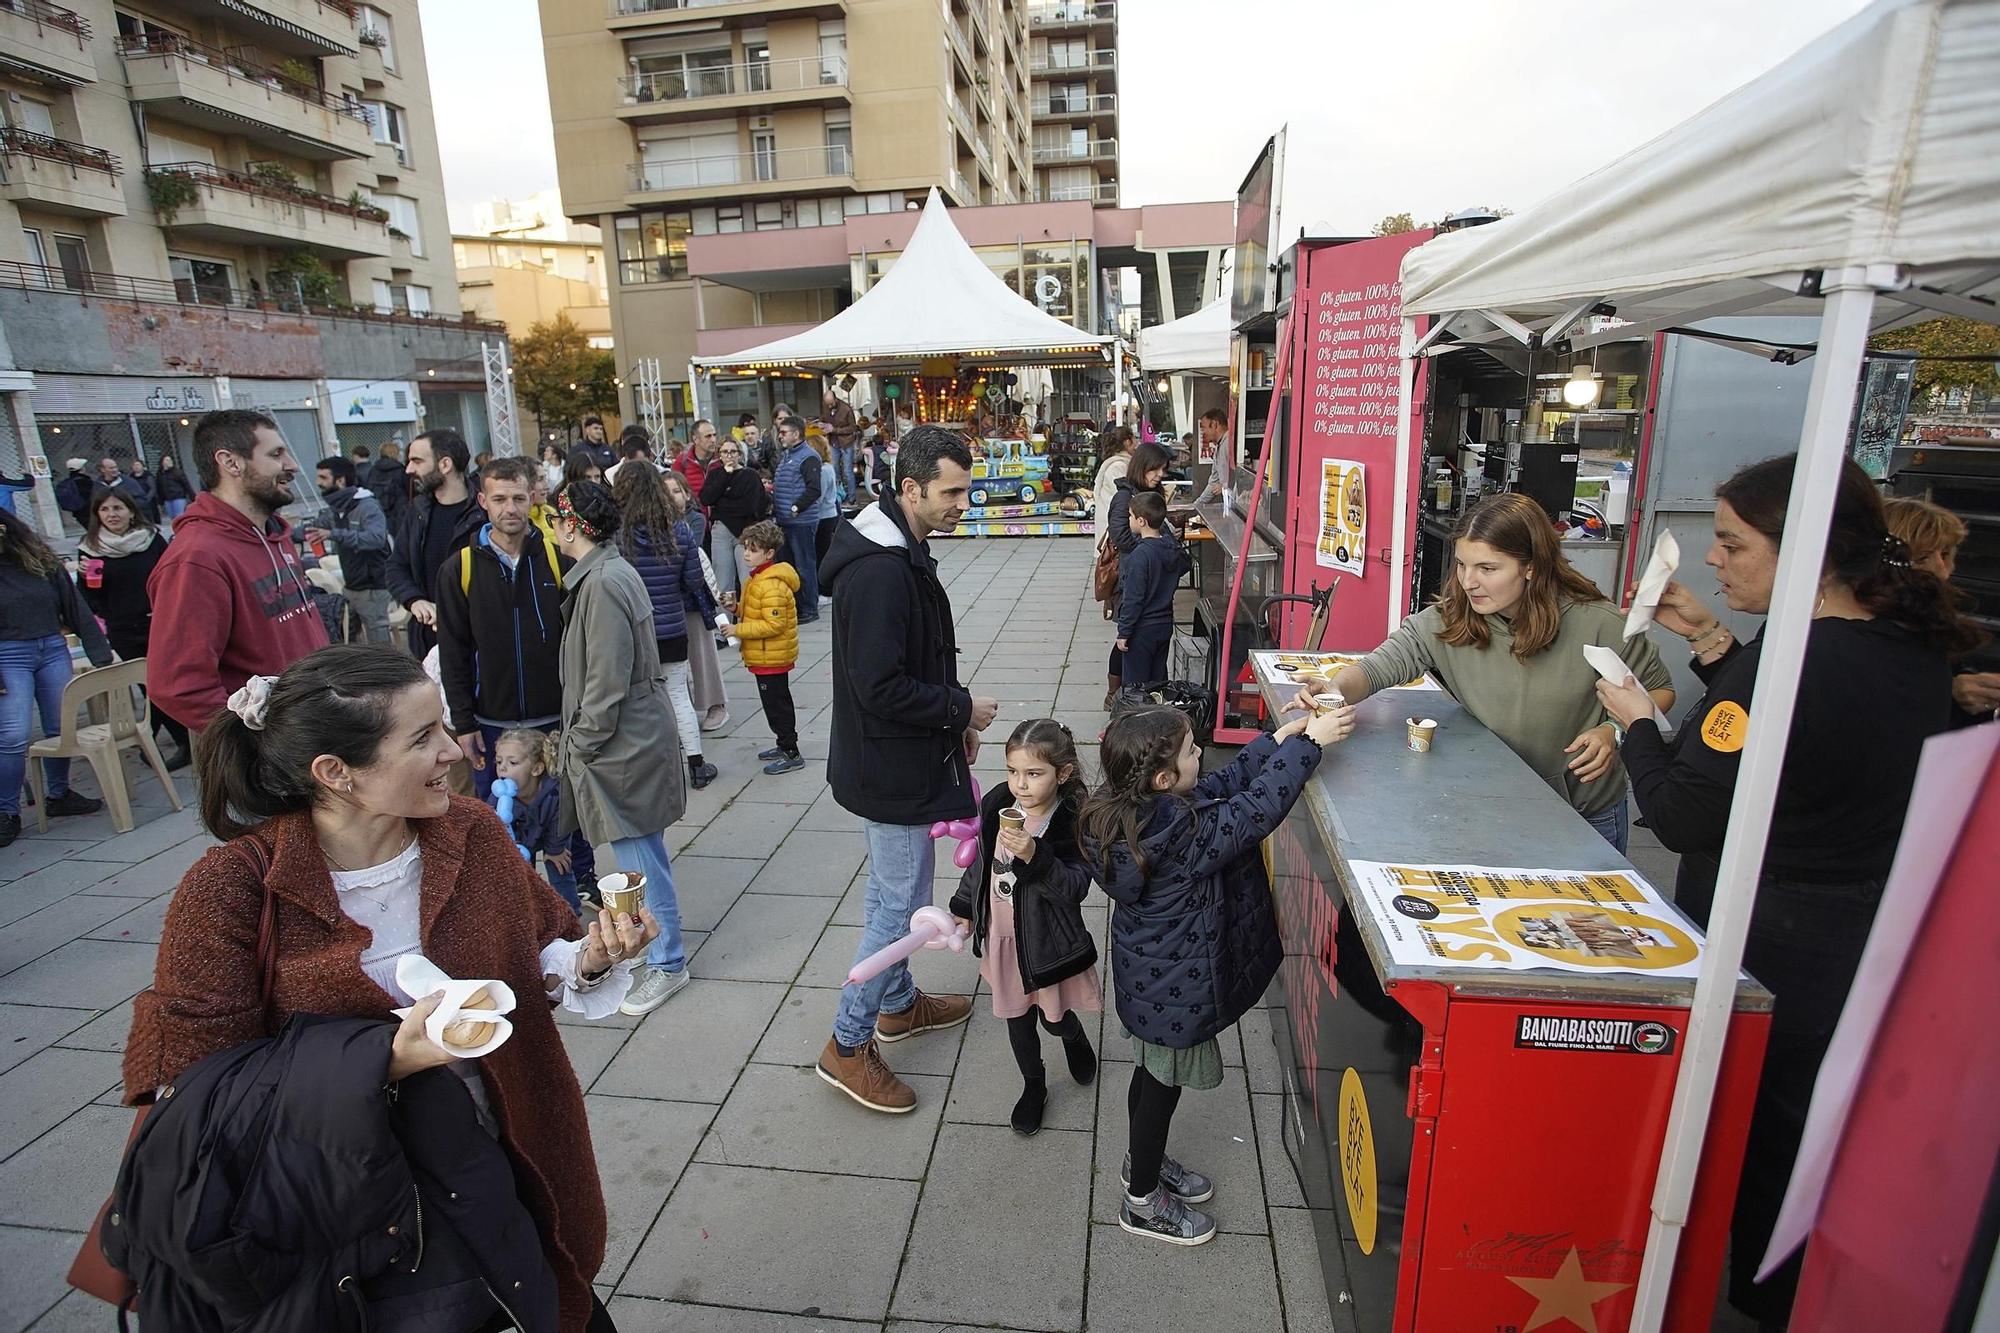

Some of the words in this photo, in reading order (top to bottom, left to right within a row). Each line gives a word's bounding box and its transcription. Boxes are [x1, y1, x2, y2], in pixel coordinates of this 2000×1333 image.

[1320, 292, 1333, 306] 0%
[1334, 290, 1362, 307] gluten.
[1365, 284, 1389, 300] 100%
[1320, 310, 1332, 324] 0%
[1333, 309, 1361, 326] gluten.
[1364, 304, 1388, 320] 100%
[1319, 329, 1331, 342] 0%
[1332, 328, 1360, 344] gluten.
[1363, 324, 1387, 340] 100%
[1318, 347, 1330, 360] 0%
[1331, 346, 1359, 363] gluten.
[1362, 344, 1386, 358] 100%
[1317, 365, 1330, 379] 0%
[1330, 365, 1358, 381] gluten.
[1361, 363, 1385, 378] 100%
[1316, 384, 1329, 397] 0%
[1329, 383, 1357, 400] gluten.
[1360, 383, 1383, 397] 100%
[1315, 402, 1328, 415] 0%
[1328, 402, 1356, 418] gluten.
[1358, 402, 1382, 416] 100%
[1314, 420, 1327, 432] 0%
[1327, 420, 1355, 436] gluten.
[1357, 421, 1380, 434] 100%
[1714, 718, 1733, 731] BYE
[1718, 709, 1736, 722] BYE
[1708, 726, 1732, 742] BLAT
[1432, 870, 1458, 898] MARIBEL
[1446, 871, 1481, 906] ORQUESTRA
[1310, 871, 1339, 1000] FREE
[1521, 1017, 1633, 1045] BANDABASSOTTI
[1350, 1096, 1364, 1144] BYE
[1347, 1118, 1363, 1176] BYE
[1346, 1146, 1364, 1211] BLAT
